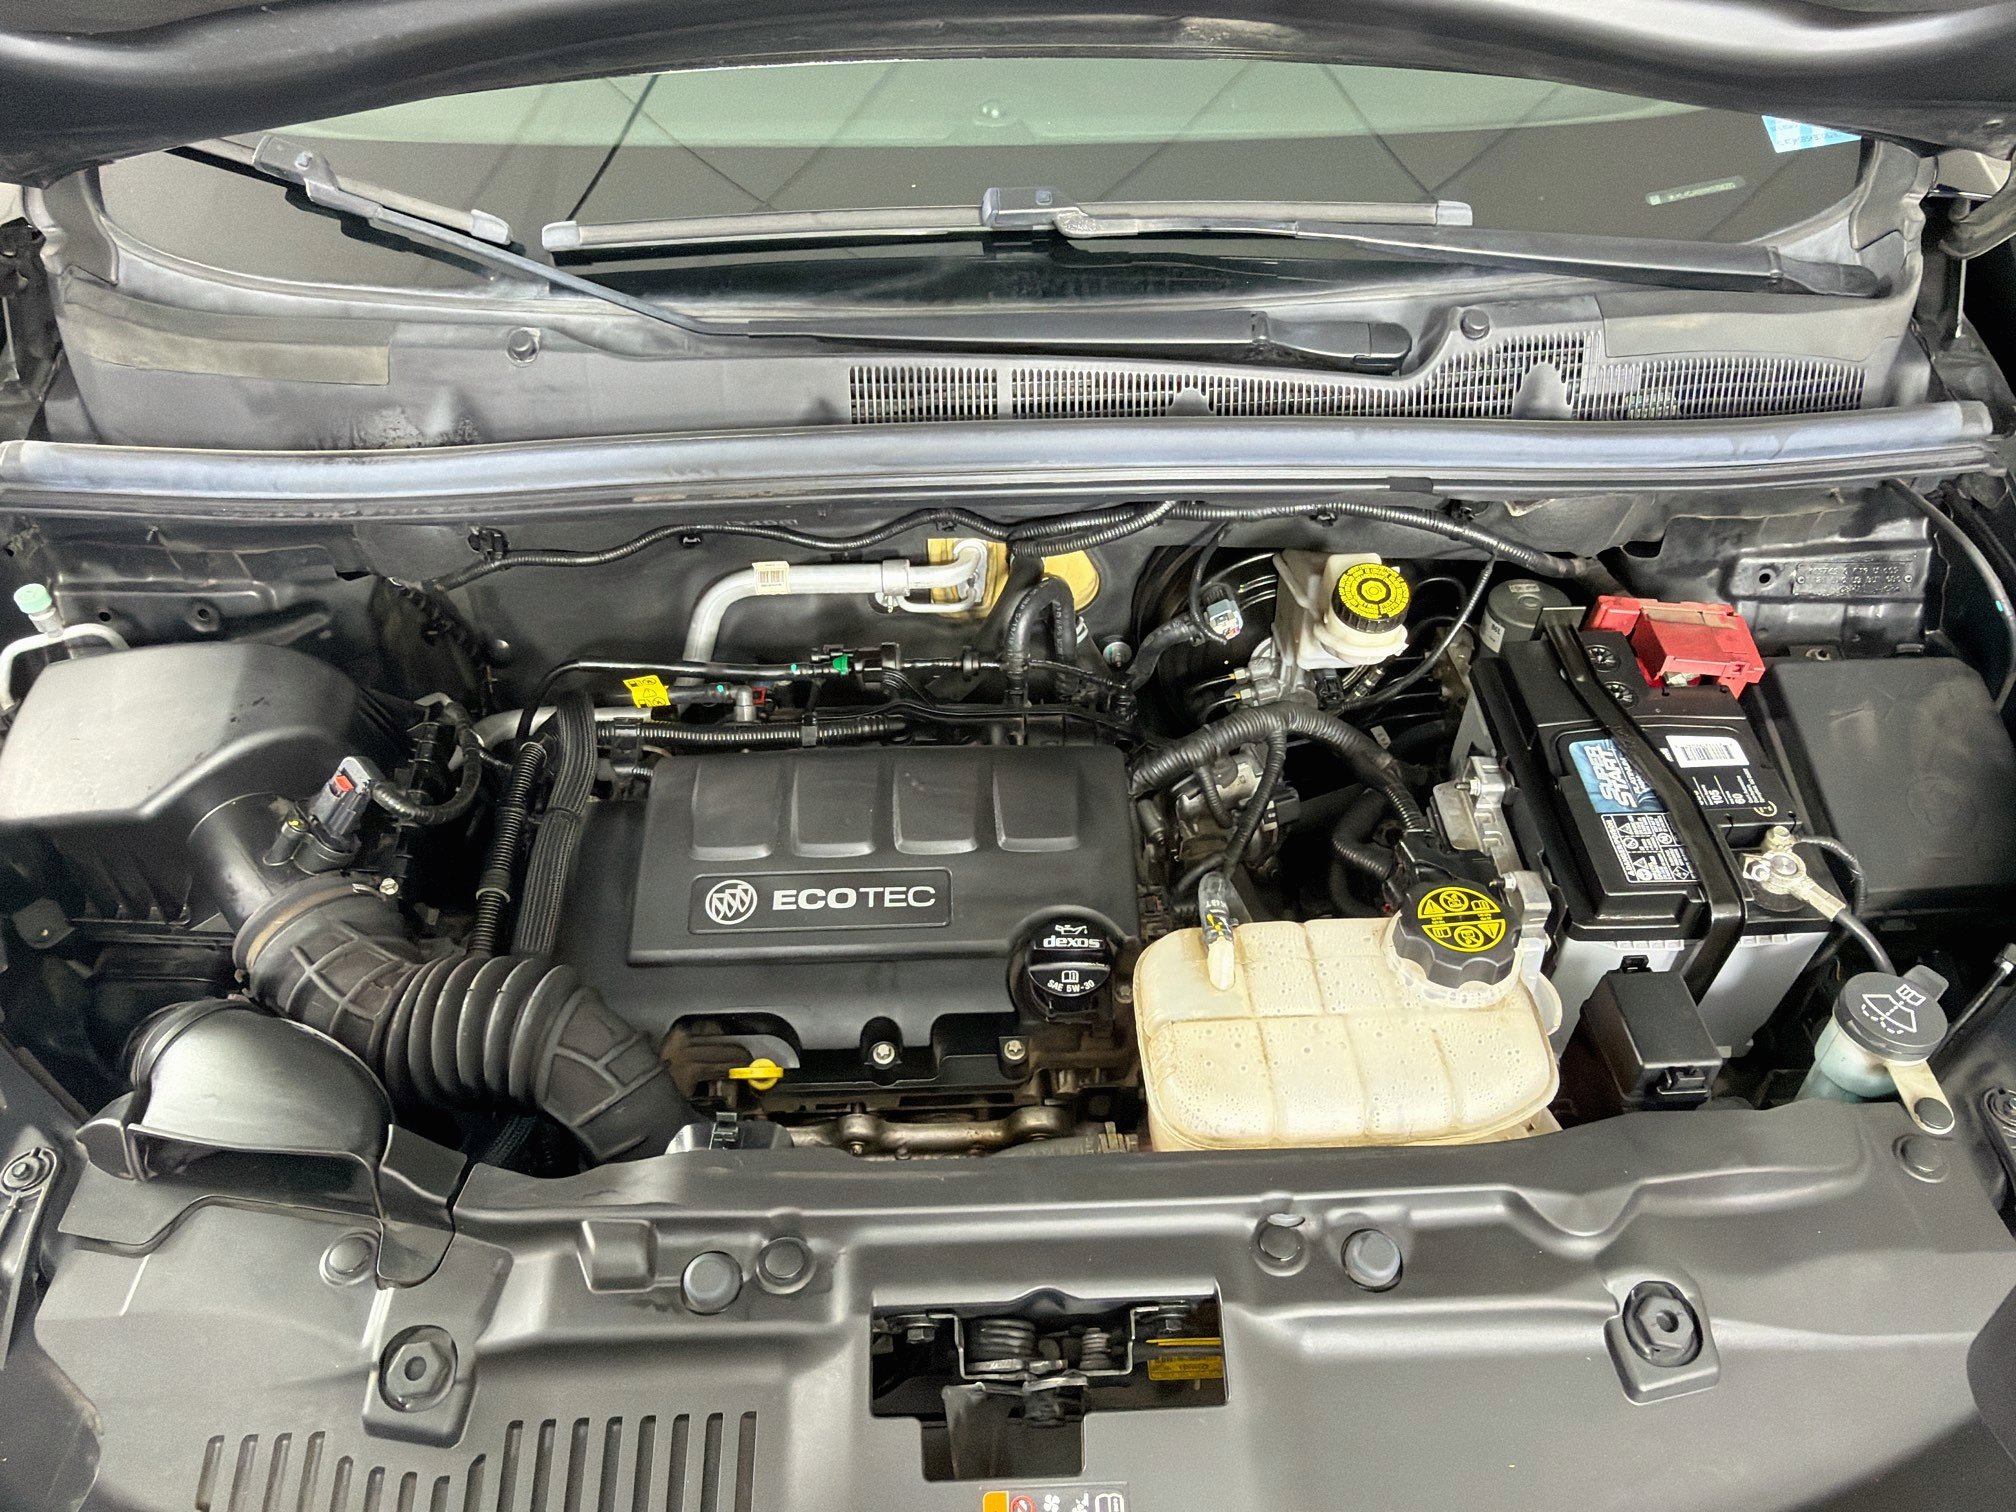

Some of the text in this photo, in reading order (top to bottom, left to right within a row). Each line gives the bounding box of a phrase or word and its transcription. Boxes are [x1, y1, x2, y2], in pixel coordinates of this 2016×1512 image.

[1583, 745, 1615, 800] SUPER
[1600, 744, 1638, 808] START
[1708, 789, 1724, 805] 105
[1731, 793, 1746, 804] 60
[772, 886, 936, 911] ECOTEC
[1043, 935, 1101, 948] dexos
[1047, 979, 1096, 993] SAE 5W-30
